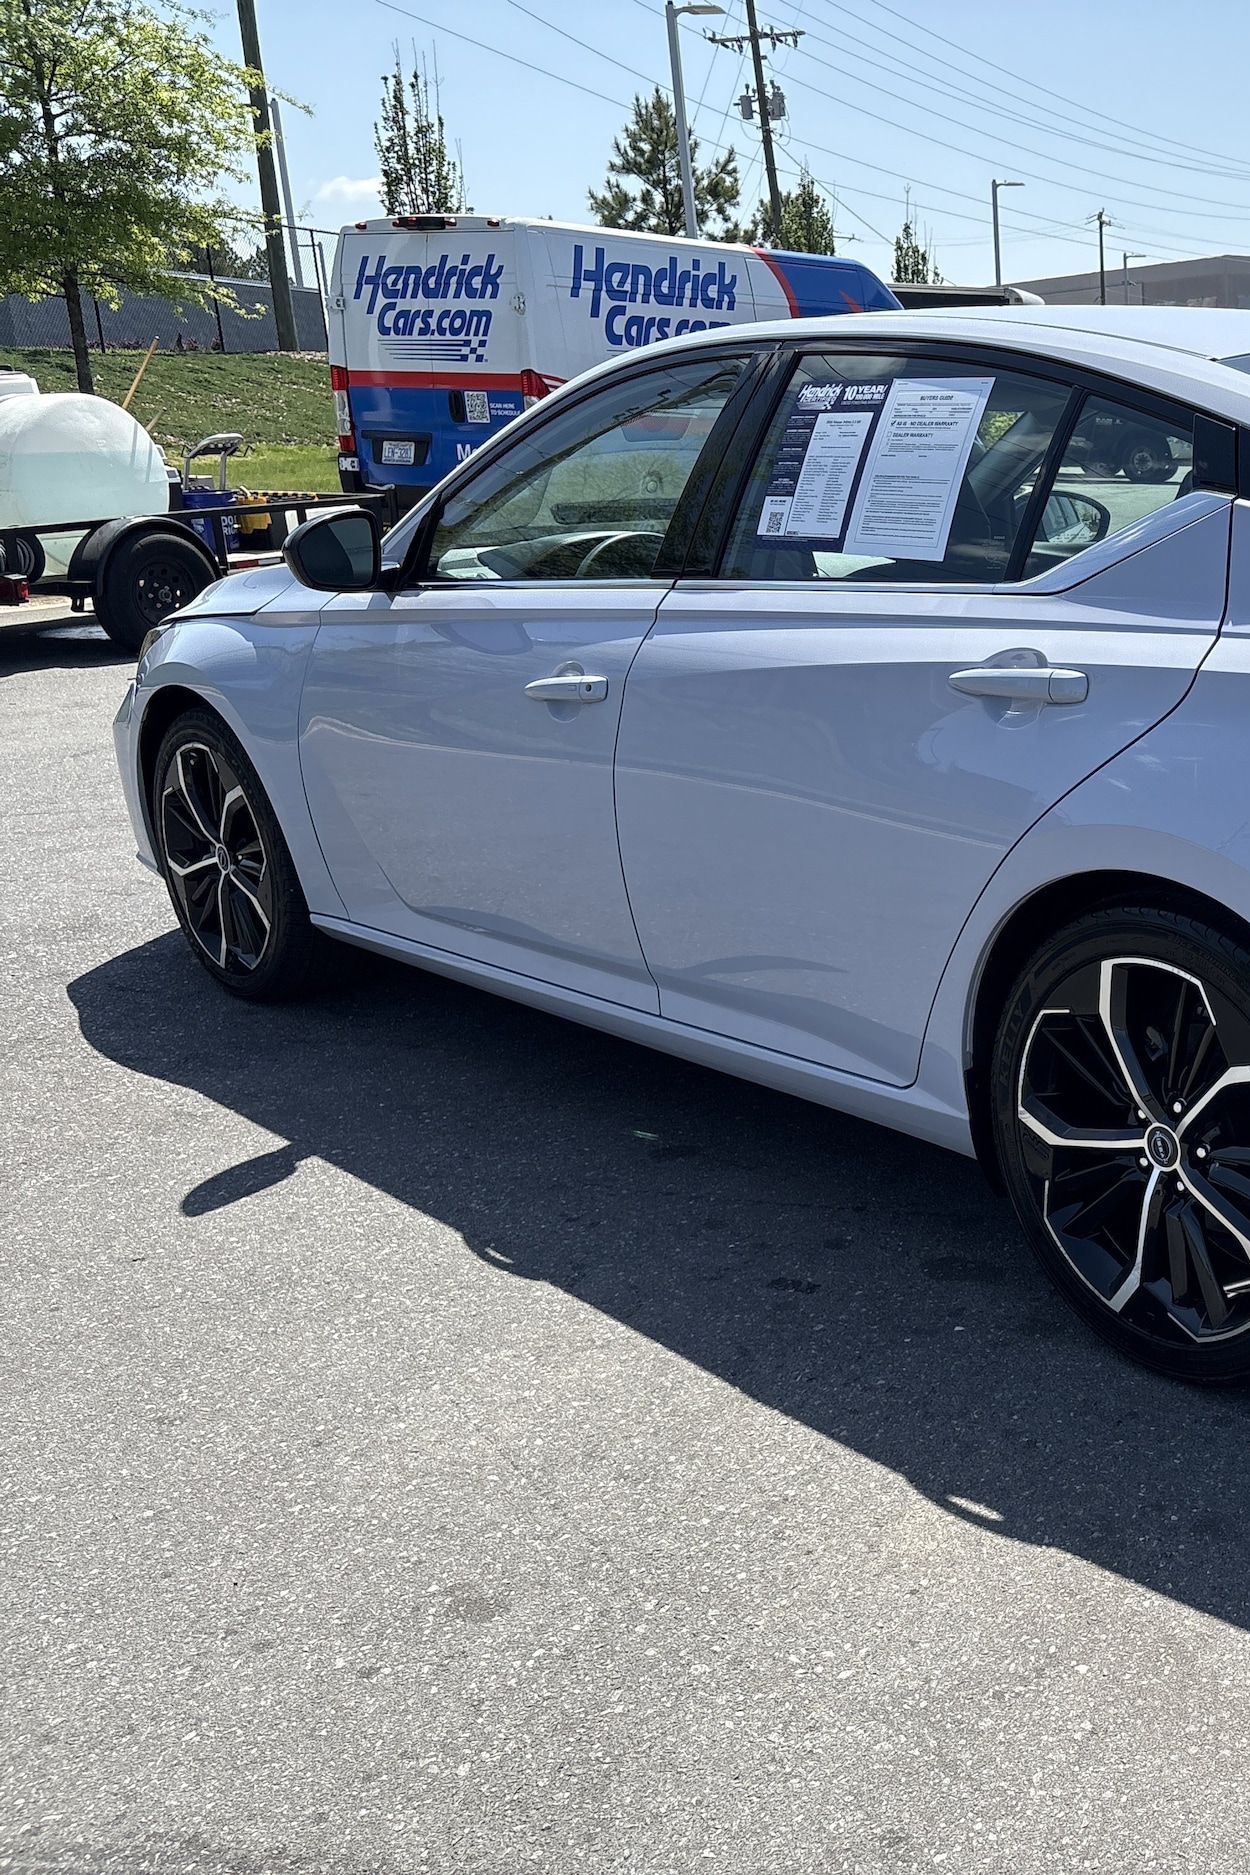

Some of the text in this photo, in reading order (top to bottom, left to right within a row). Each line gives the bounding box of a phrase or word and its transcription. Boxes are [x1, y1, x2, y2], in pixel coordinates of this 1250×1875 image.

[353, 254, 504, 315] Hendrick
[570, 244, 738, 318] Hendrick
[377, 301, 493, 337] Cars.com
[798, 383, 843, 402] Hendrick
[843, 385, 858, 401] 10
